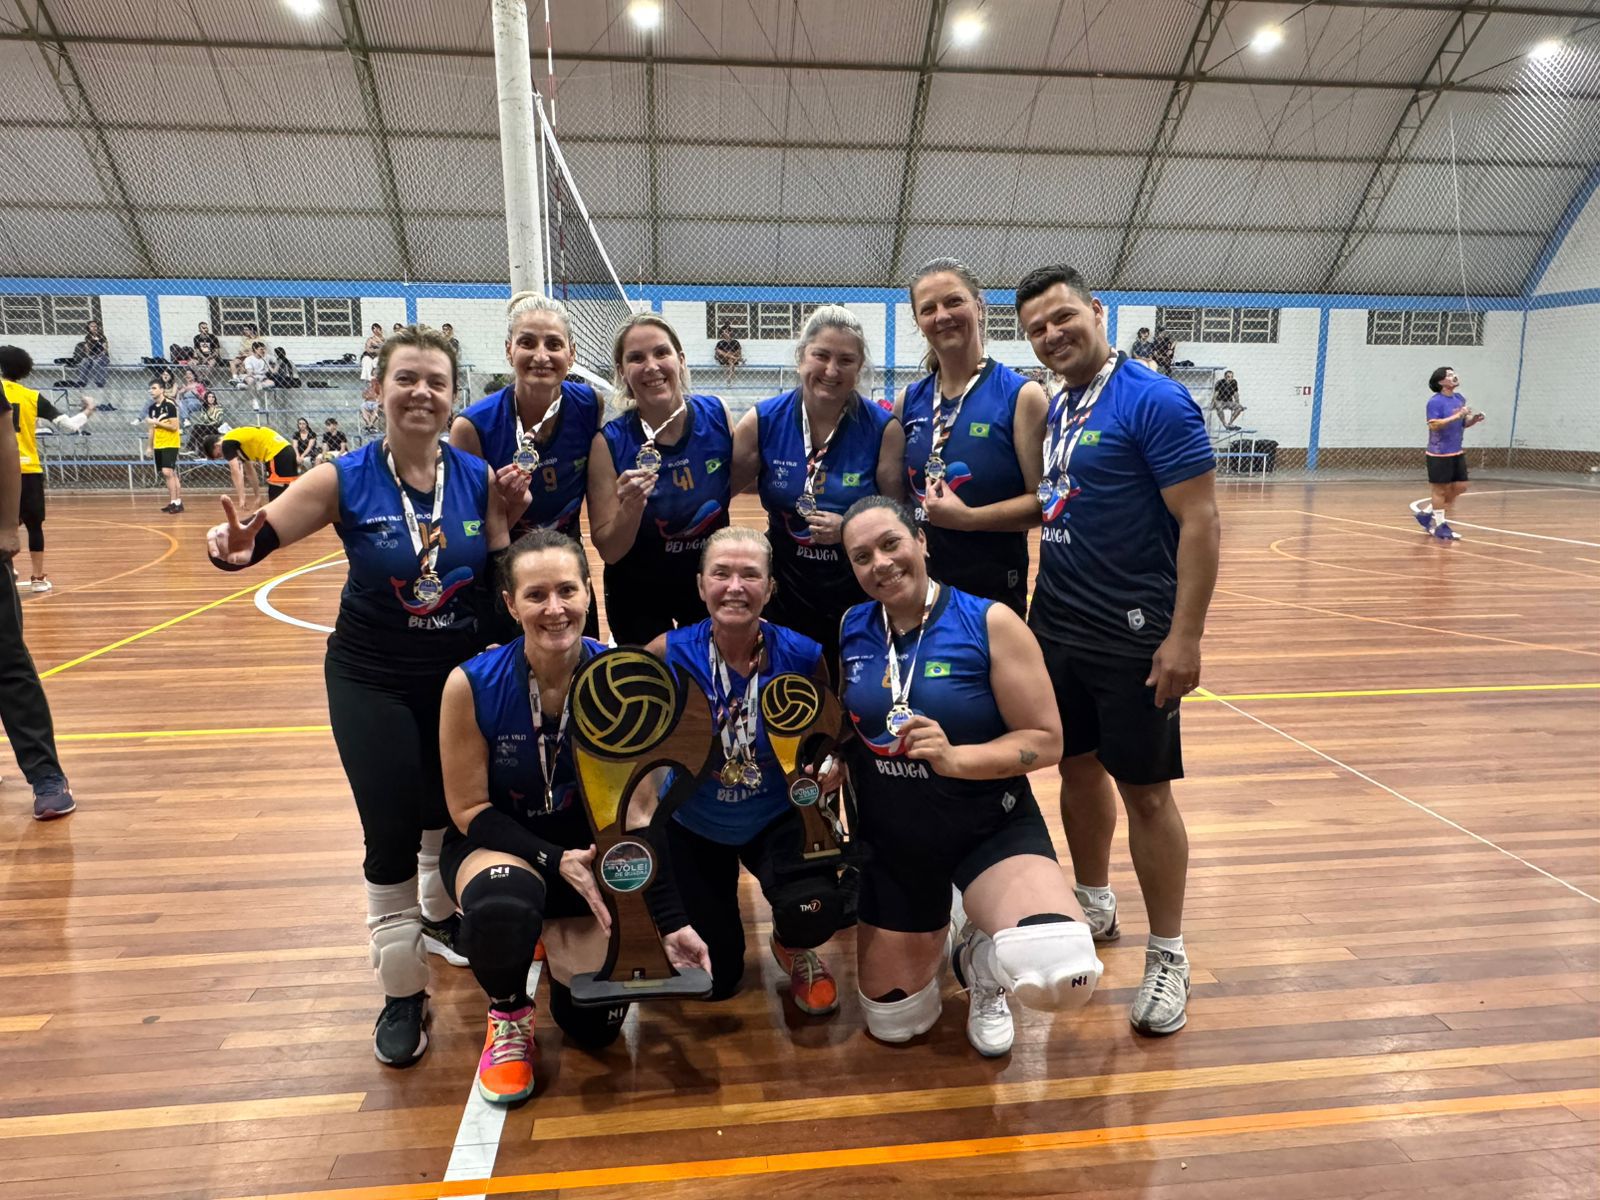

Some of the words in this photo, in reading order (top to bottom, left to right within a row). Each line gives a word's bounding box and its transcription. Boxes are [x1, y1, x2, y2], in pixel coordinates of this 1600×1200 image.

[542, 467, 558, 493] 9
[672, 466, 695, 491] 41
[796, 545, 840, 561] BELUGA
[874, 759, 930, 779] BELUGA
